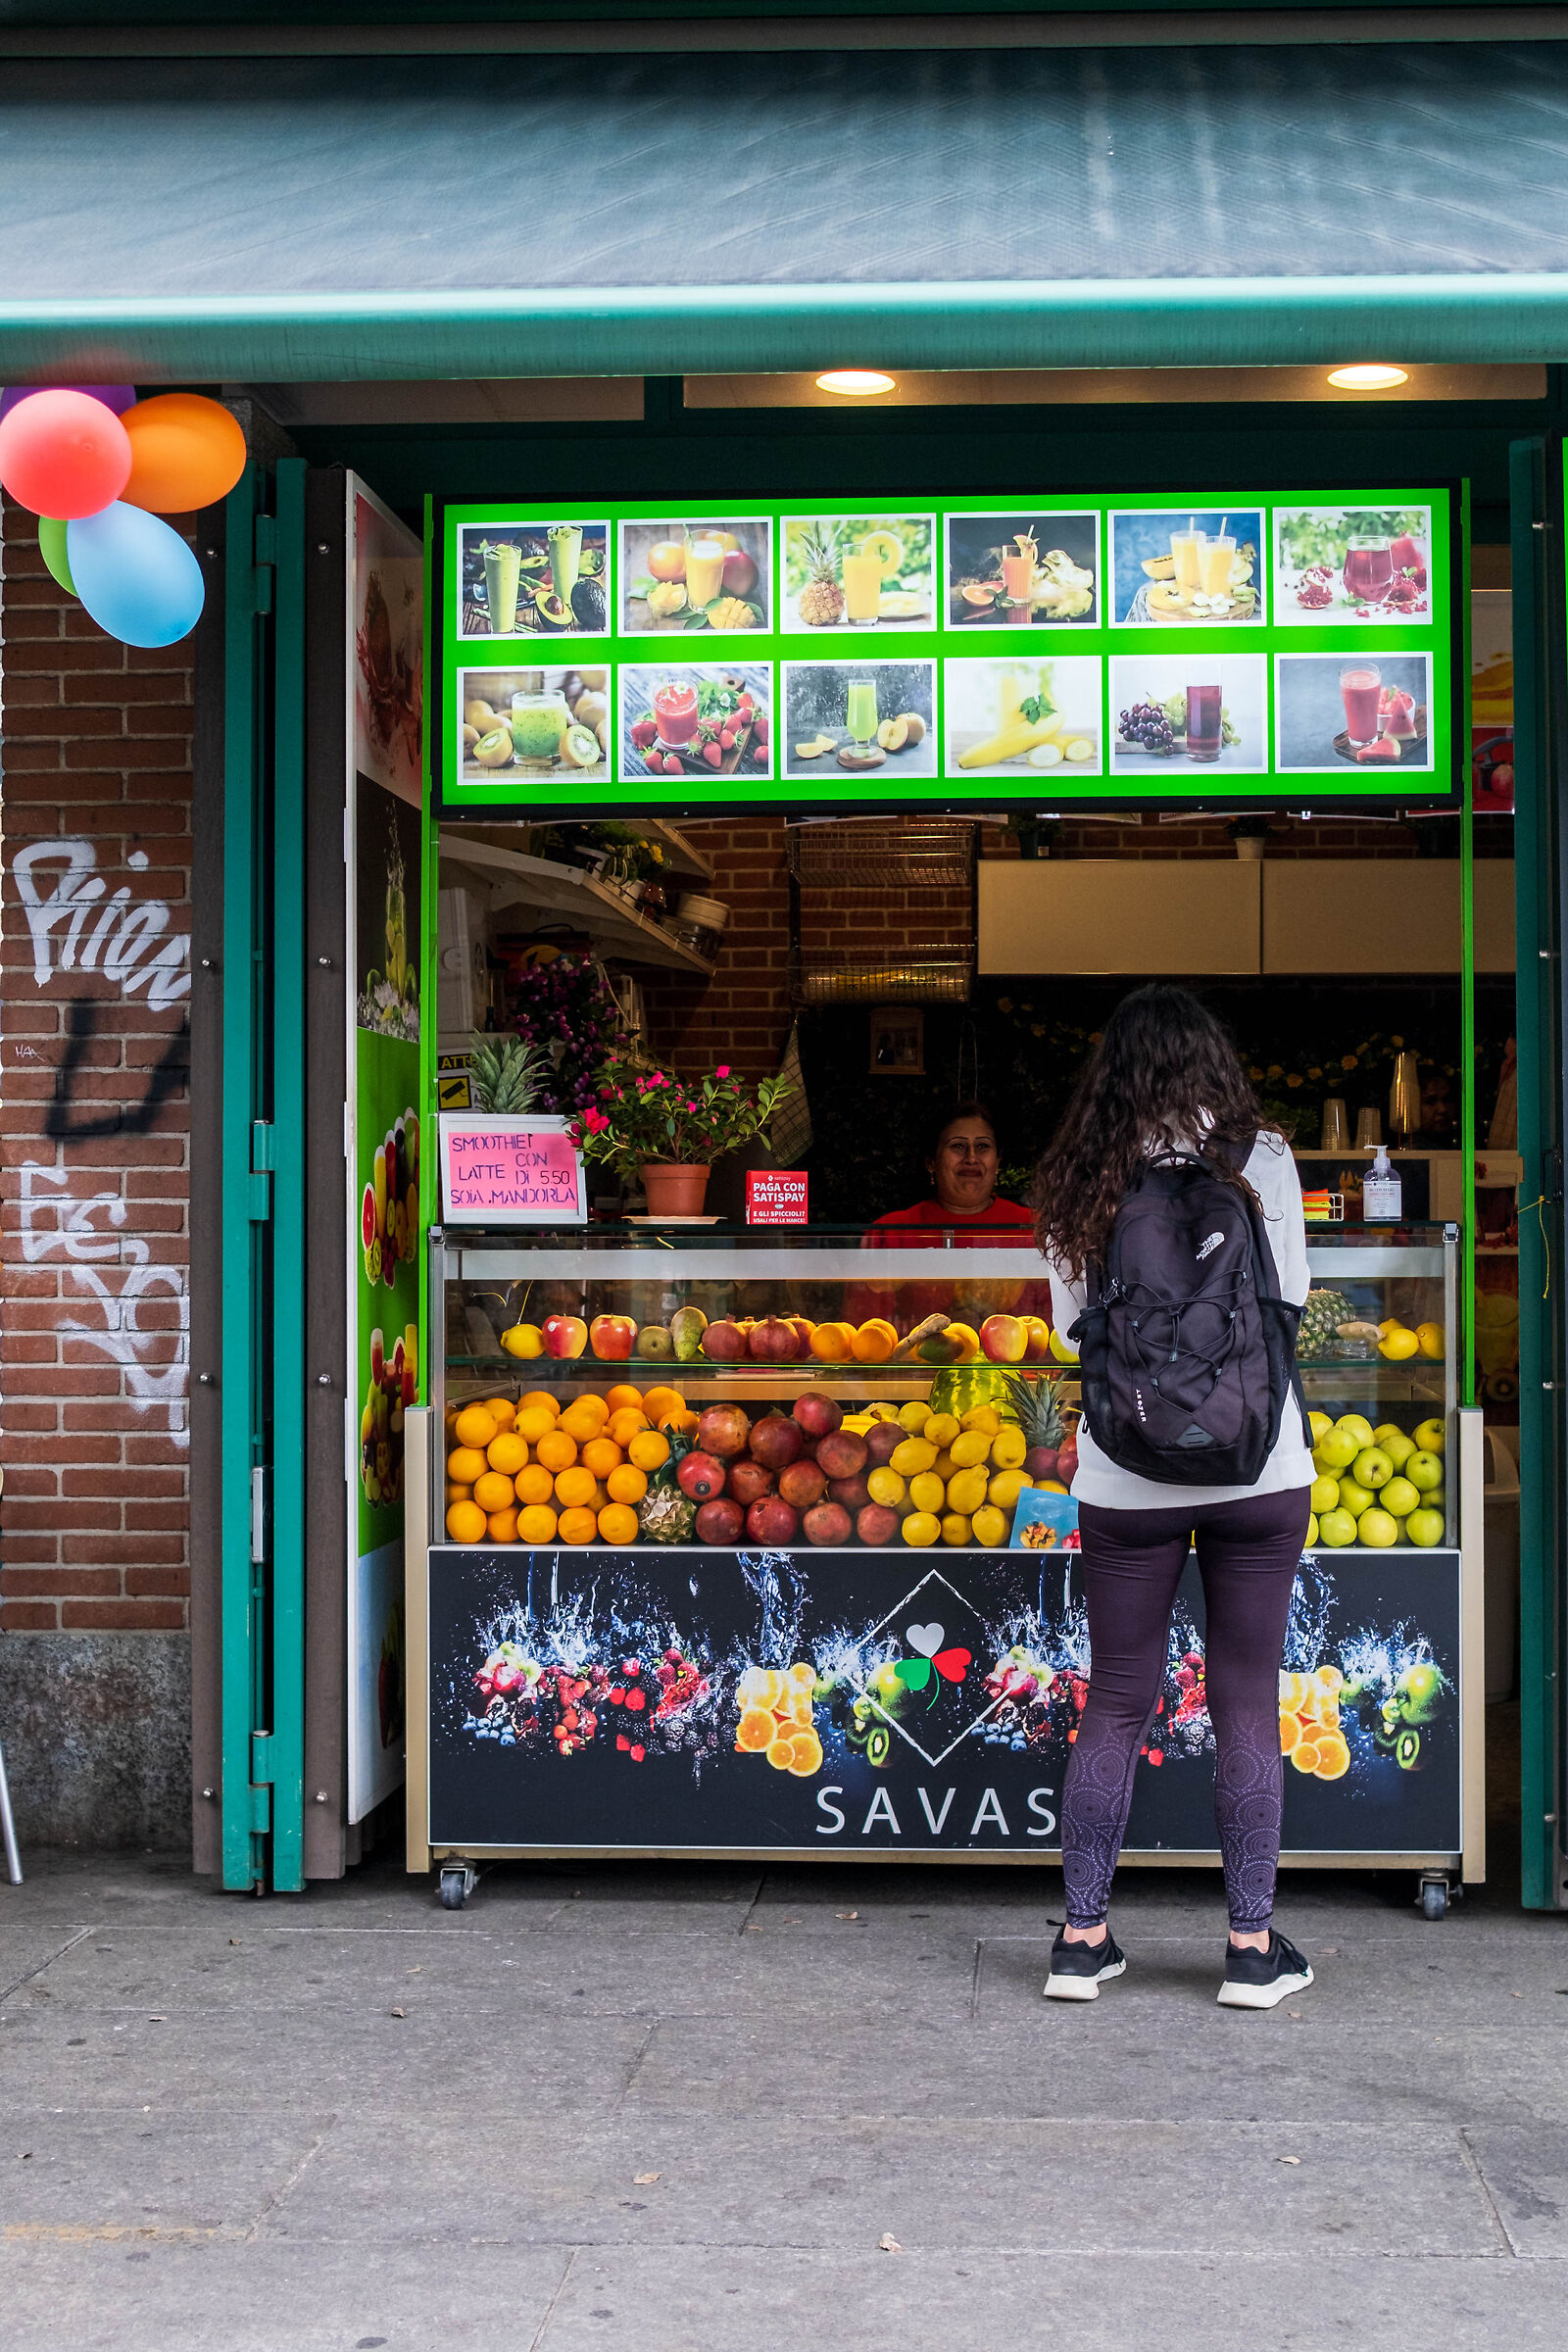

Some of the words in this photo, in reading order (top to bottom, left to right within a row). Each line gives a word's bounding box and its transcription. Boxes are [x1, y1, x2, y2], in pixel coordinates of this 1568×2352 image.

[515, 1152, 548, 1167] CON
[459, 1163, 505, 1181] LATTE
[754, 1183, 781, 1192] PAGA
[783, 1183, 806, 1192] CON
[754, 1193, 806, 1202] SATISPAY
[815, 1786, 1057, 1836] SAVAS
